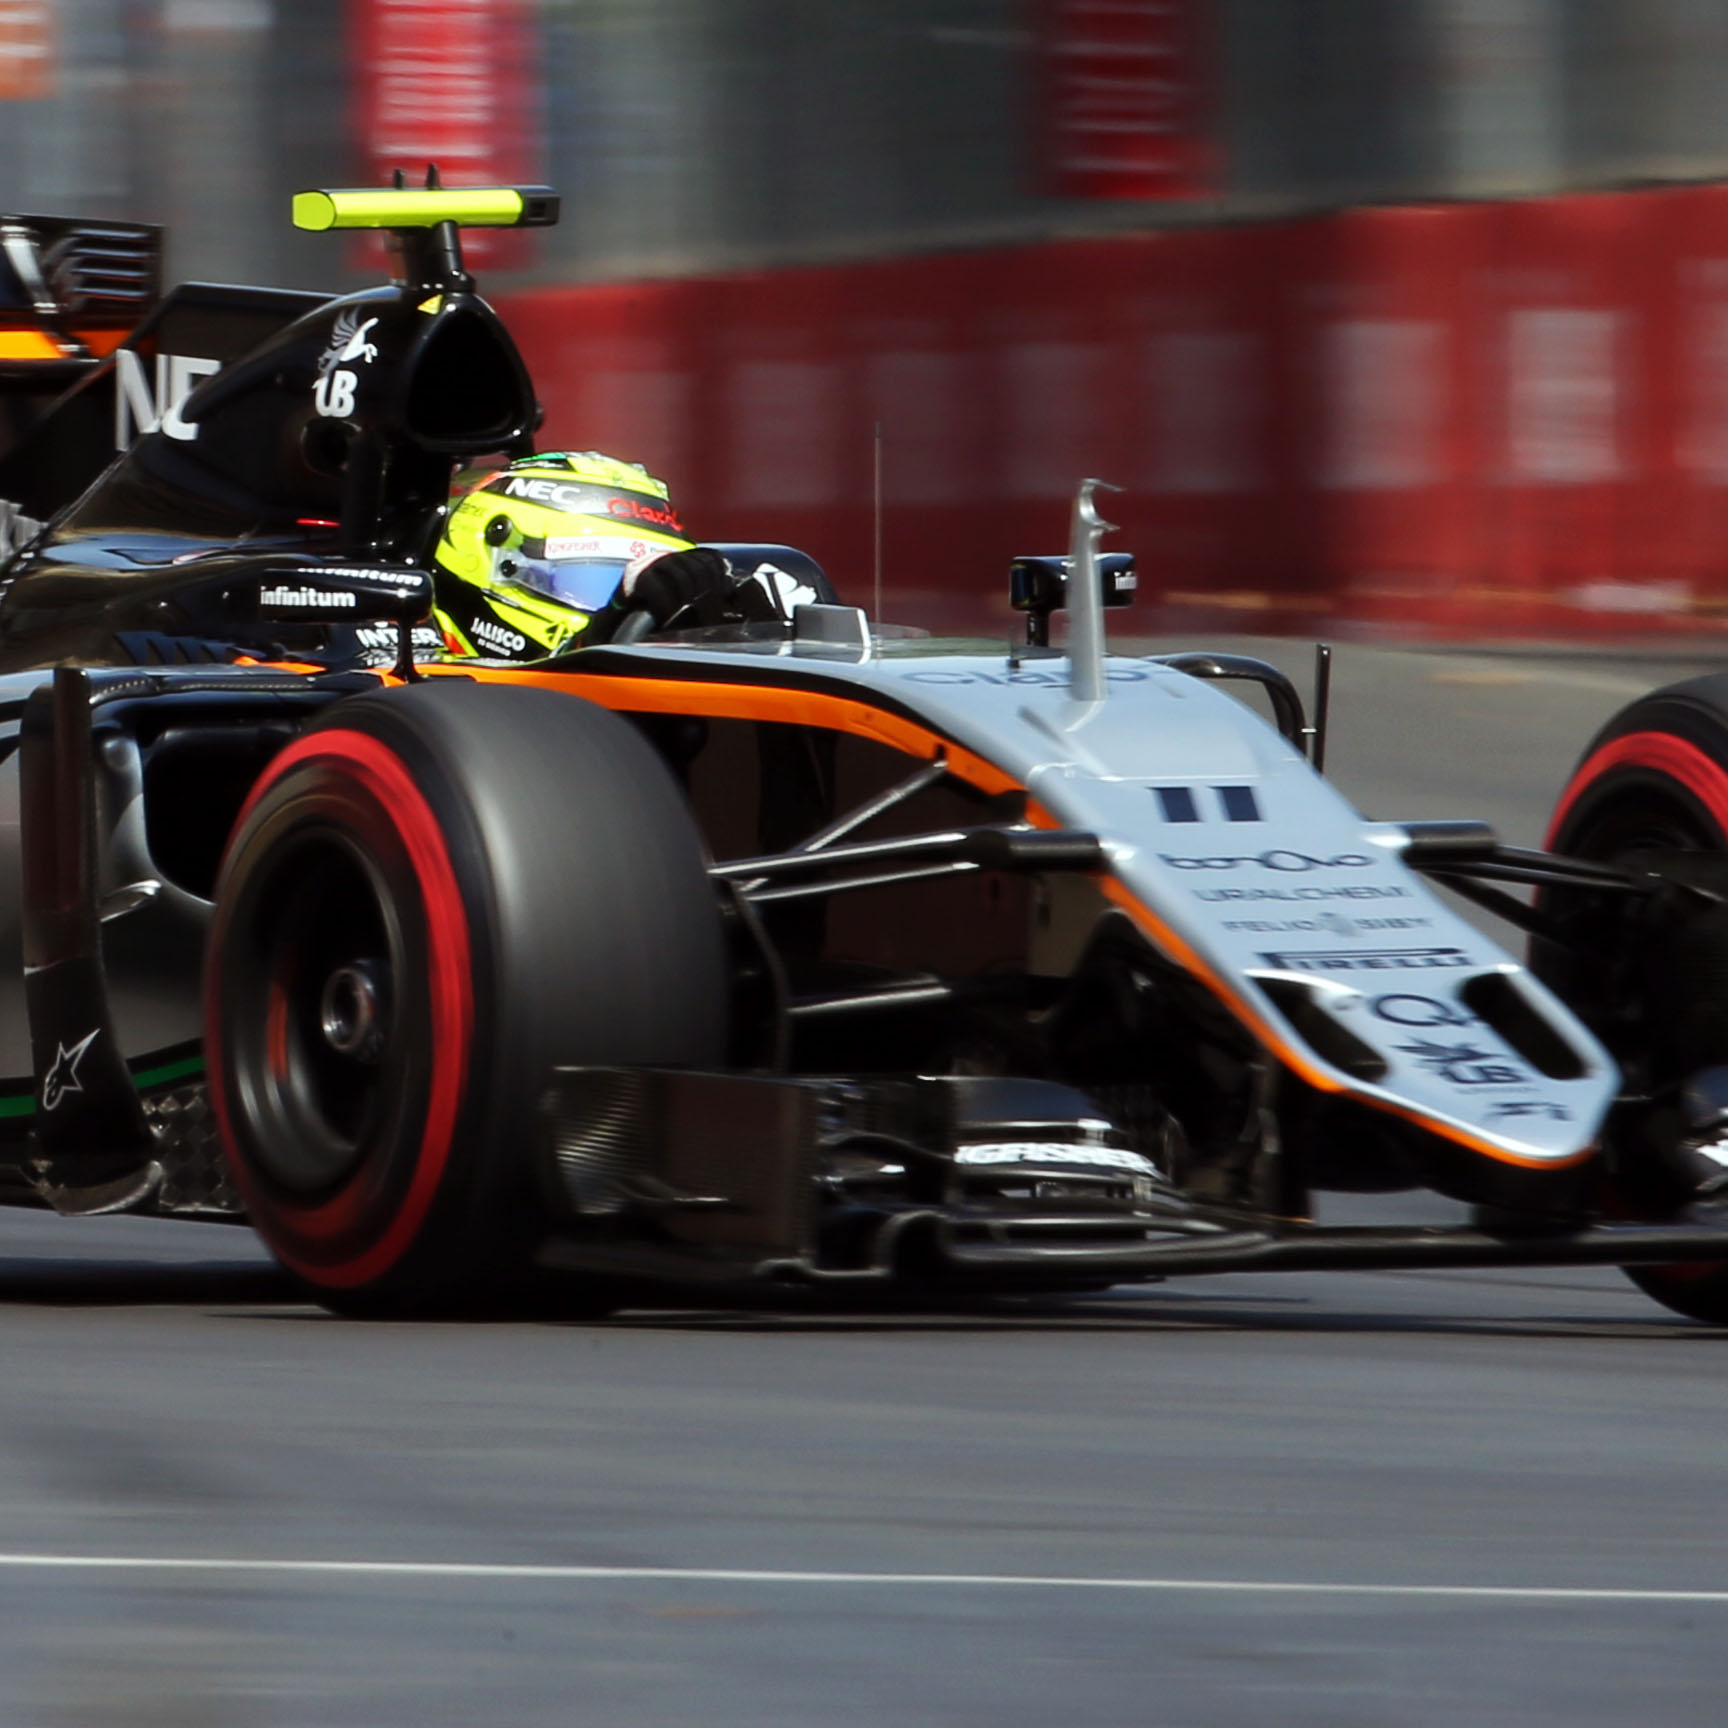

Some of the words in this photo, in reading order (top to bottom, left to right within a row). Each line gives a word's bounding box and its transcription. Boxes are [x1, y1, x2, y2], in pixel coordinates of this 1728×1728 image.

[505, 477, 581, 506] NEC
[260, 586, 356, 607] infinitum
[471, 617, 526, 652] JALISCO
[1148, 785, 1264, 822] 11
[1253, 947, 1474, 970] PIRELLI
